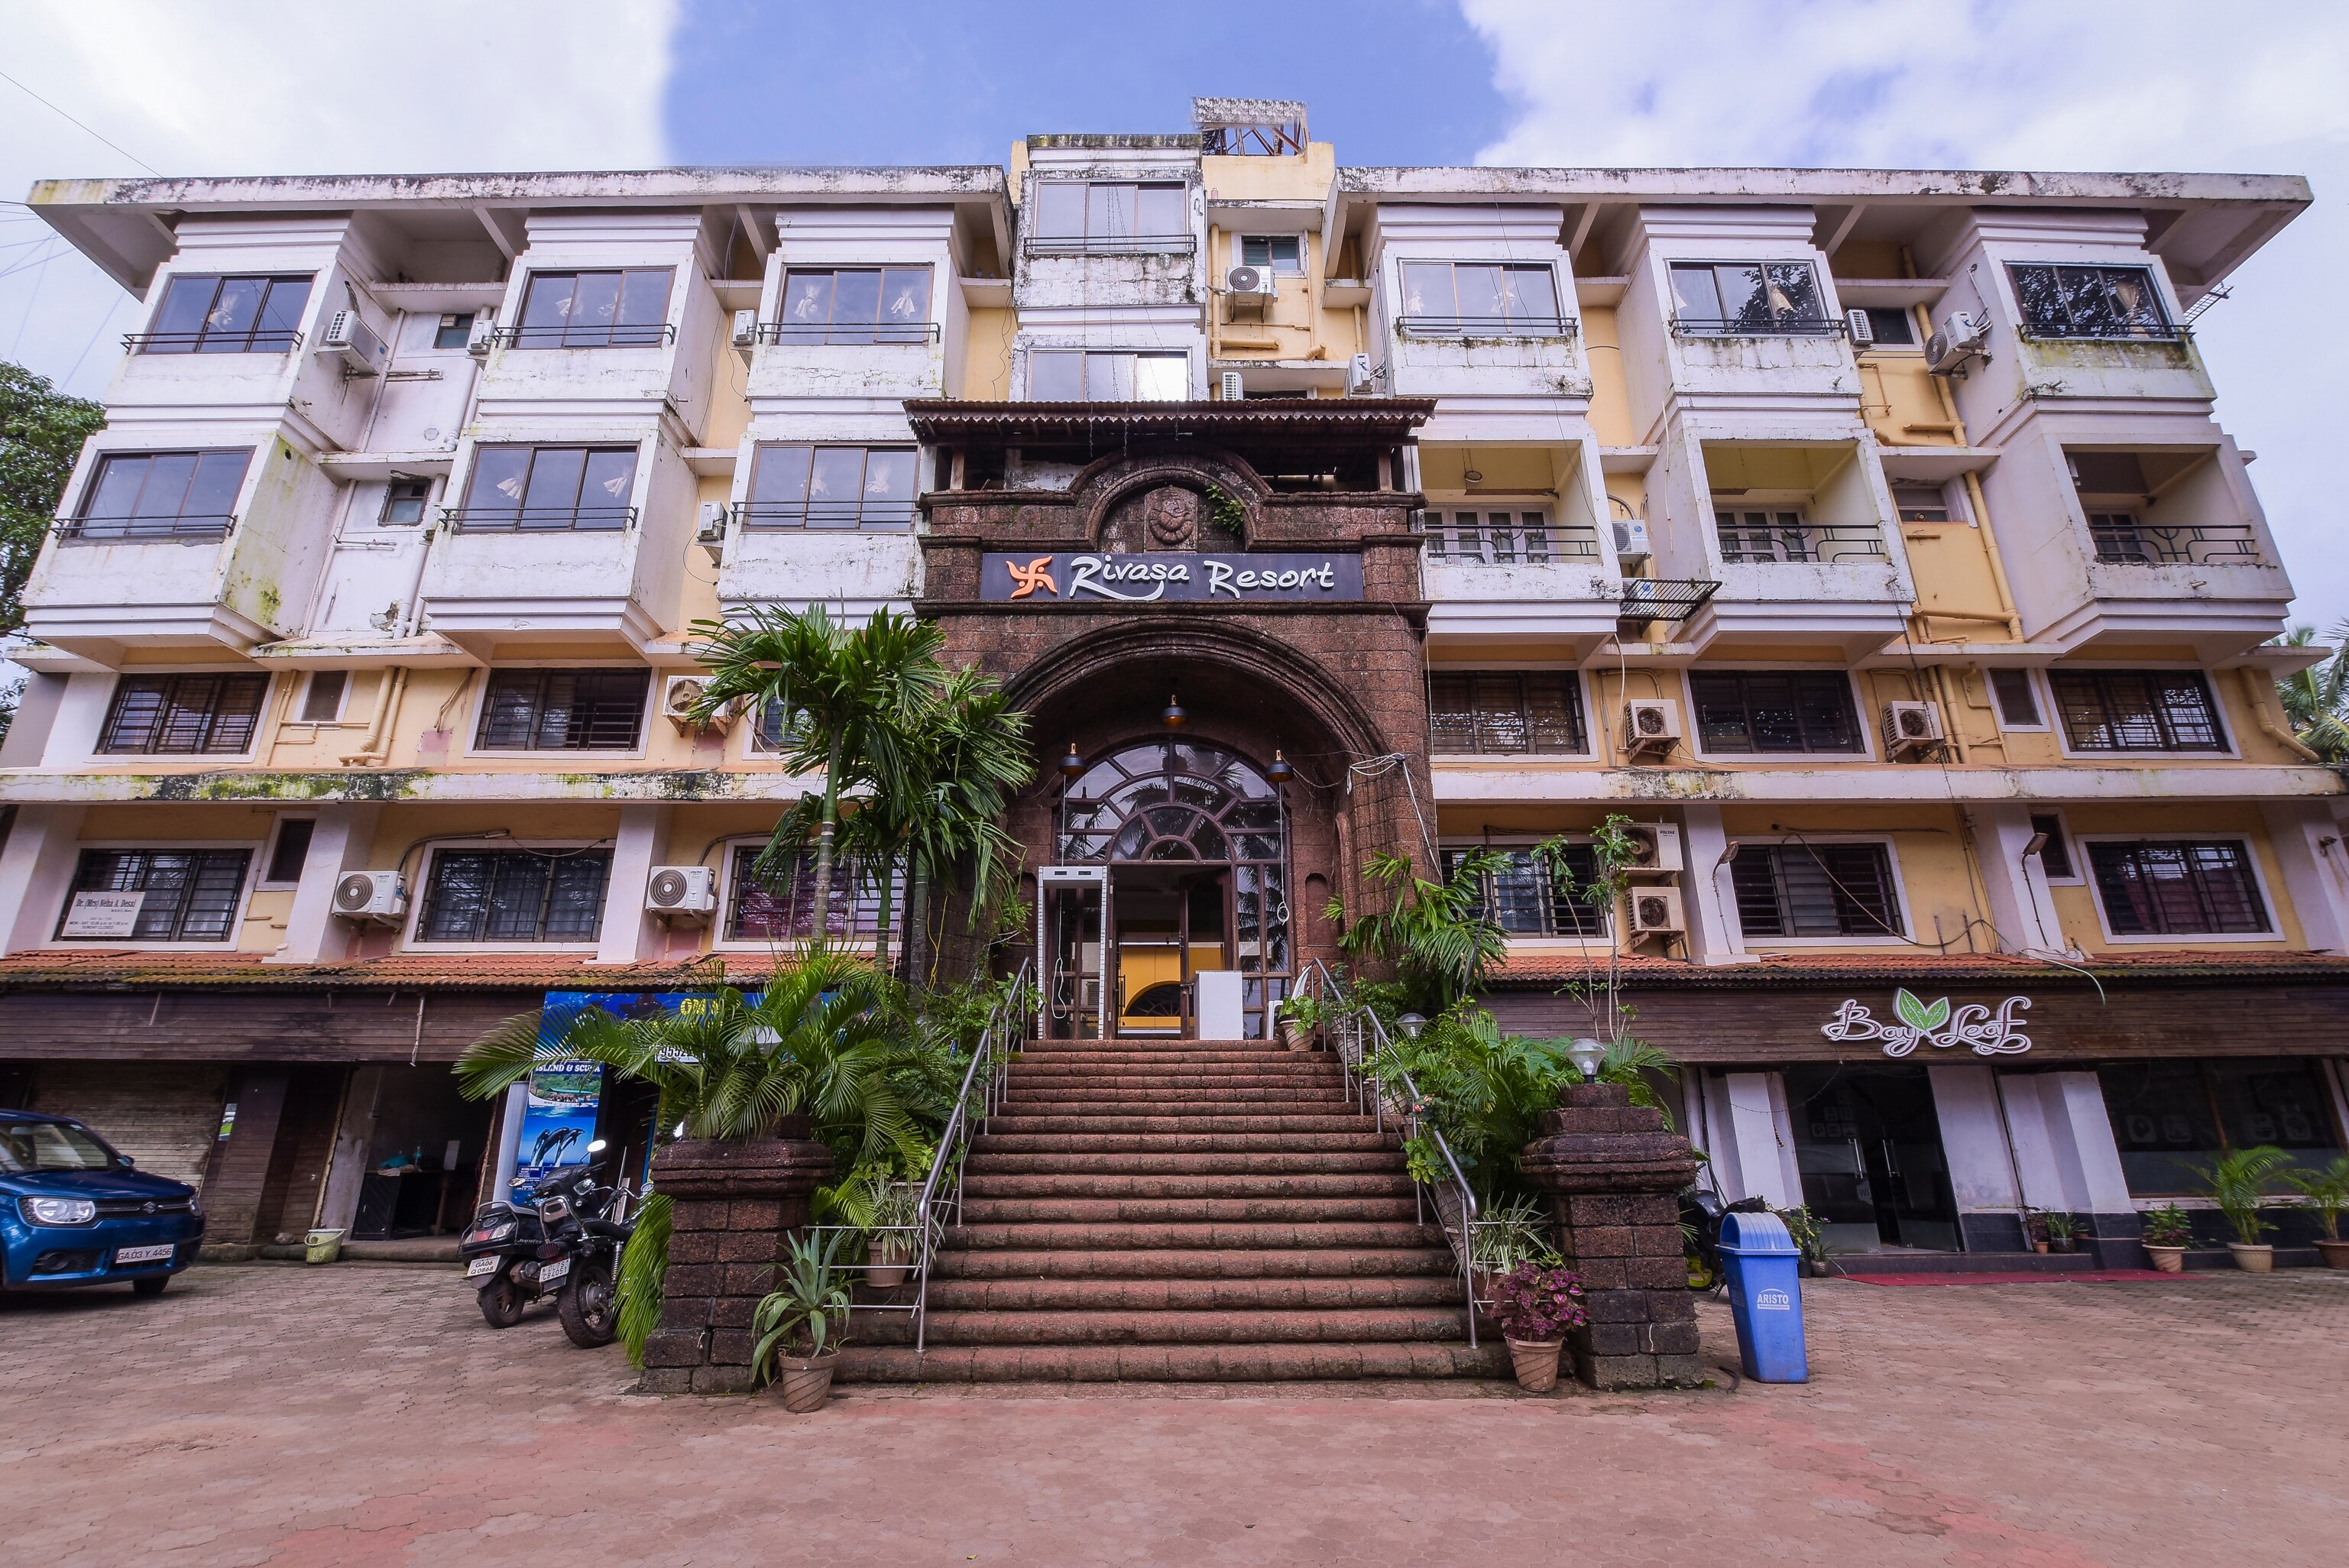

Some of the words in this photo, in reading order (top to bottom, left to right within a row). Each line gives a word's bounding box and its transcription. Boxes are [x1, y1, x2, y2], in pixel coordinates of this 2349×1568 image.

[1069, 555, 1190, 601] Rivasa
[1204, 560, 1335, 599] Resort
[75, 899, 84, 907] Dr.
[84, 899, 99, 909] (Mrs)
[99, 899, 114, 907] Neha
[120, 899, 137, 908] Desai
[1821, 999, 1920, 1058] Bay
[1929, 996, 2032, 1056] Leaf
[1757, 1294, 1789, 1304] ARISTO
